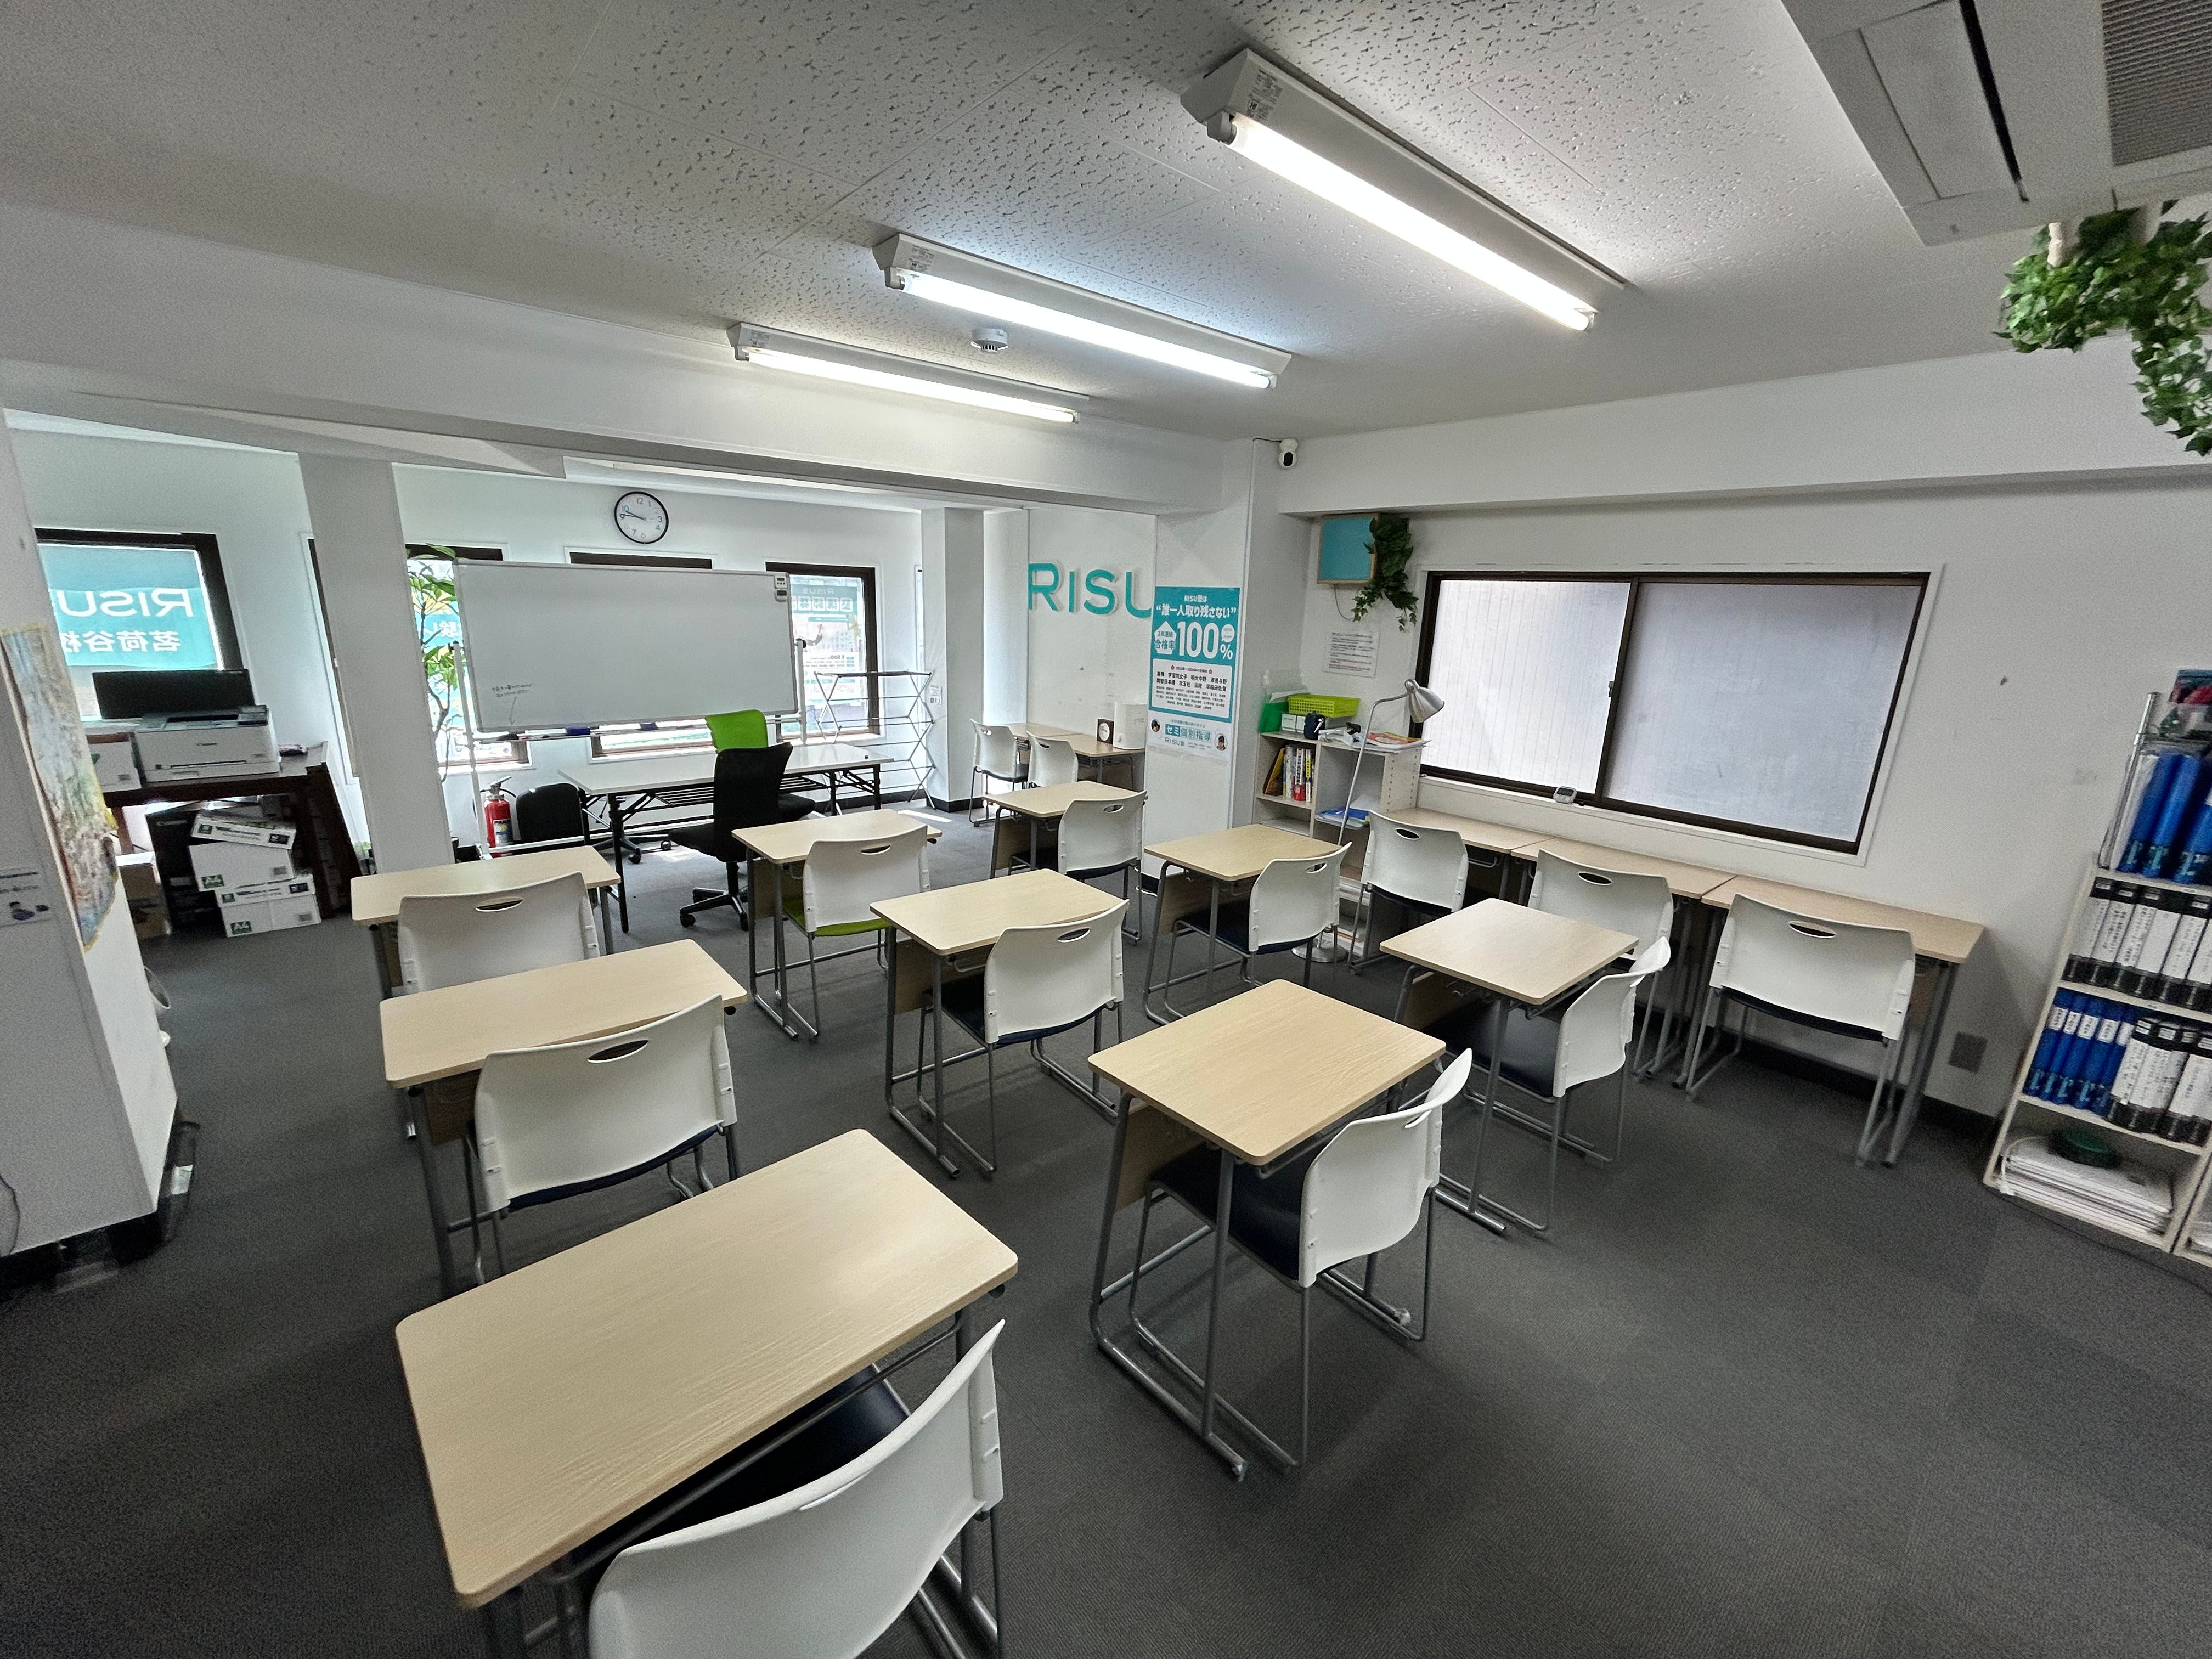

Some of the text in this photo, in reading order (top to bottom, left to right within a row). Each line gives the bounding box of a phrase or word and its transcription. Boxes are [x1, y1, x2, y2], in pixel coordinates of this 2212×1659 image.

[1028, 563, 1152, 618] RISU
[1155, 639, 1175, 650] 合格率
